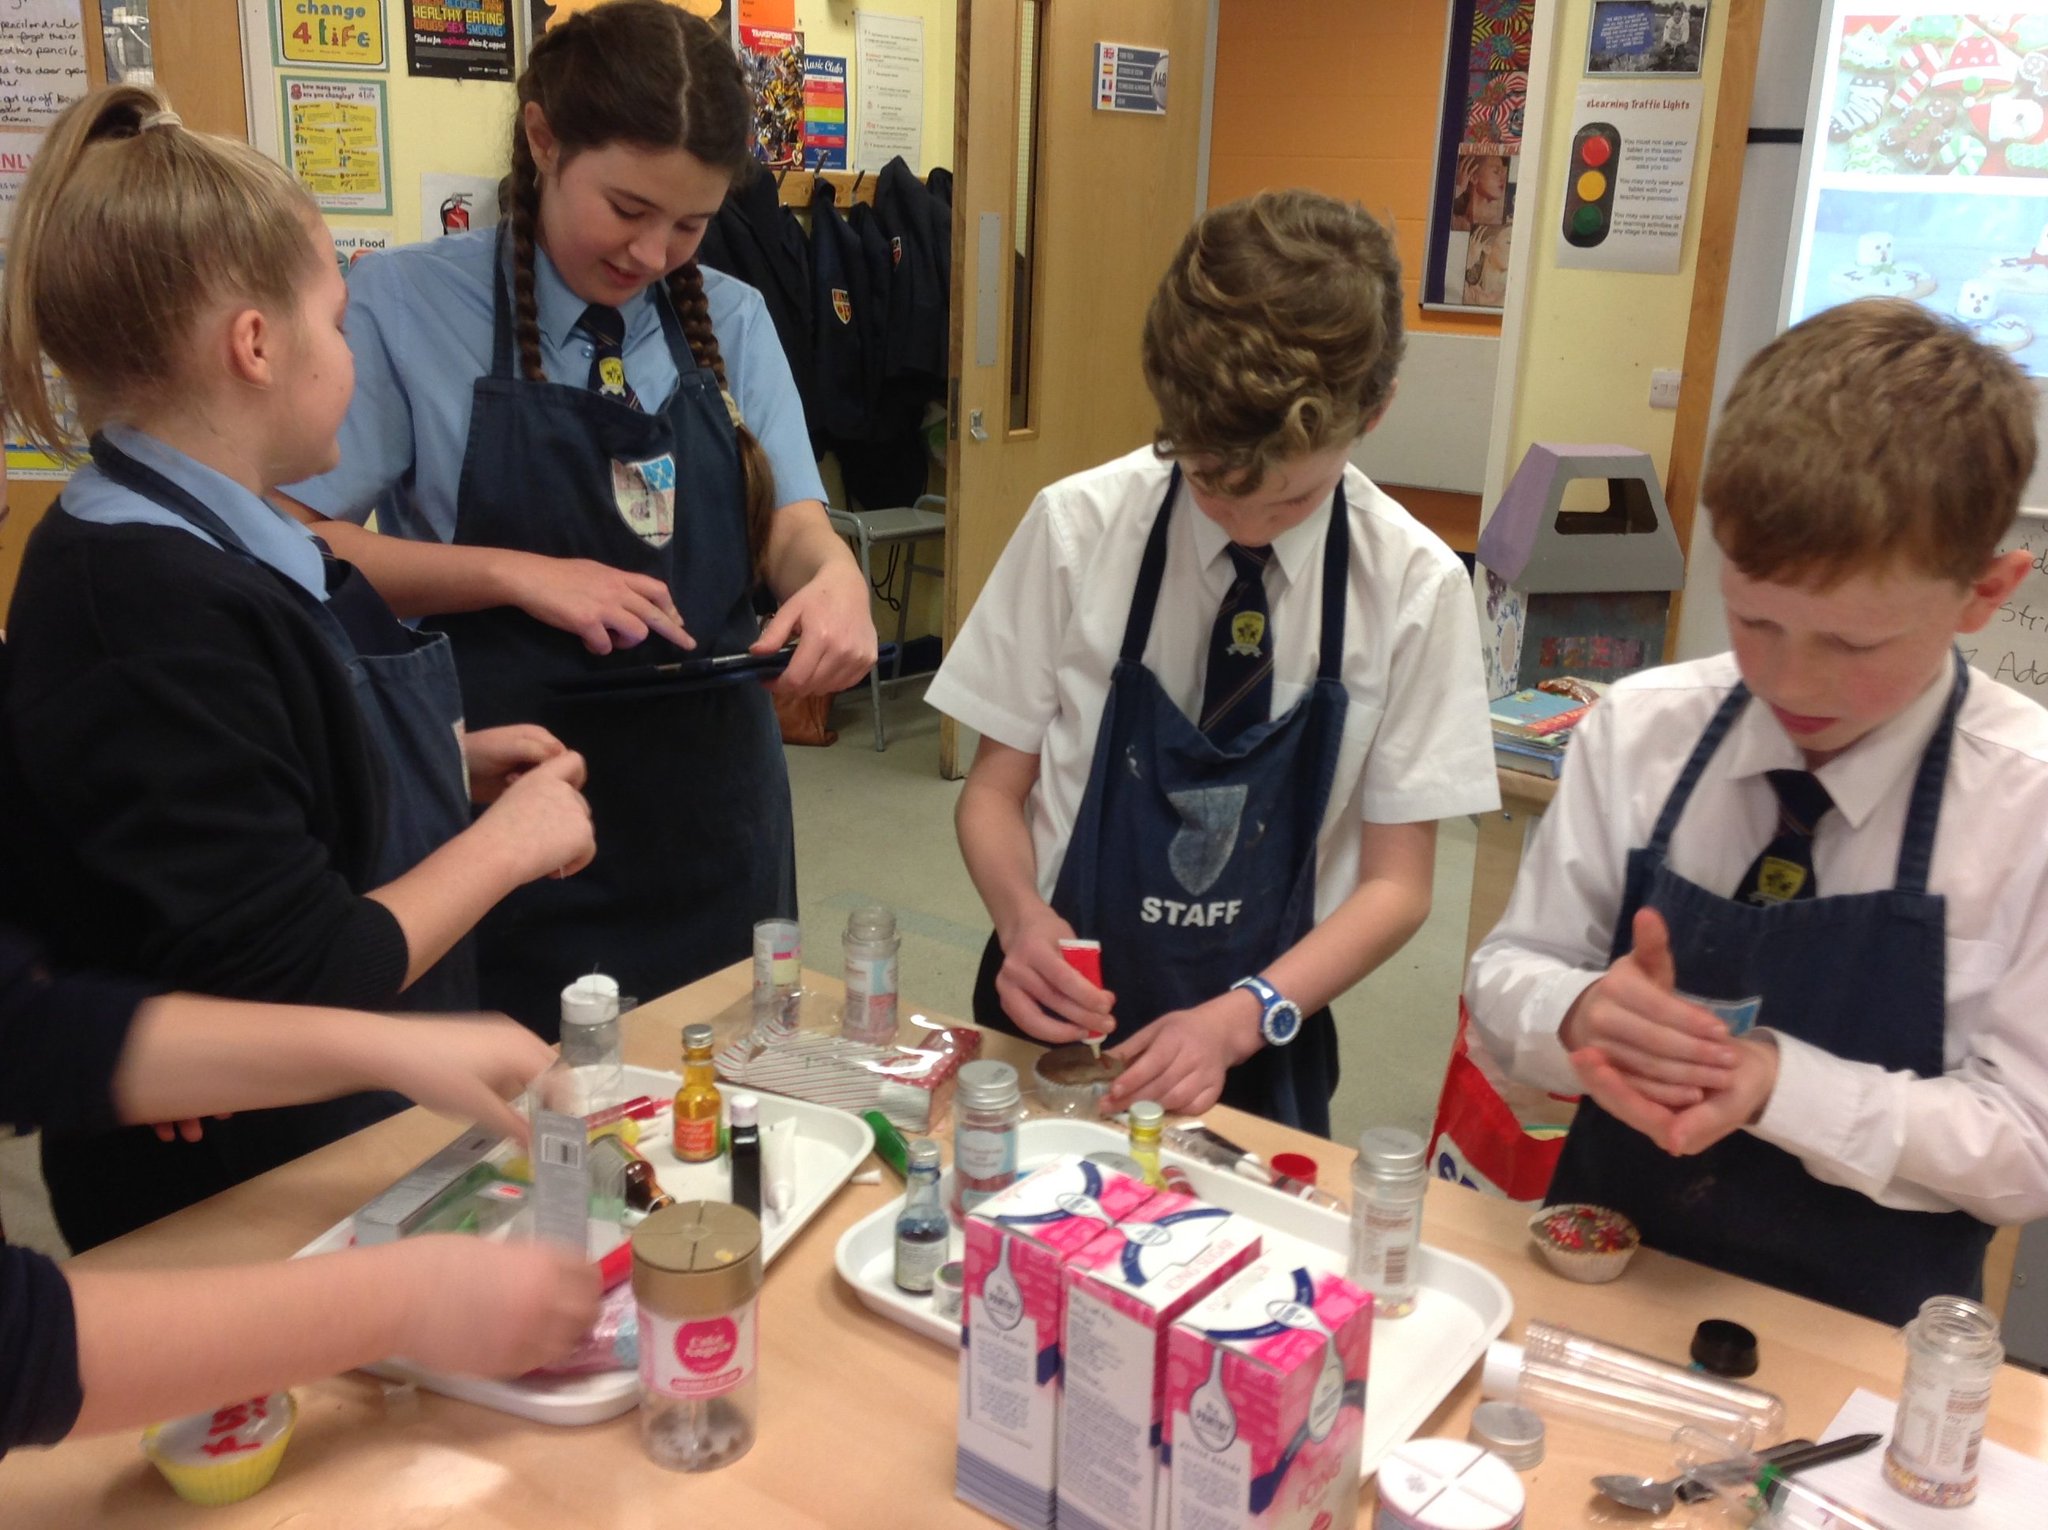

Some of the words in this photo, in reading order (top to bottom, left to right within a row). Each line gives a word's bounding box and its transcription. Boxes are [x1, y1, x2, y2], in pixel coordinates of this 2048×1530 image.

[296, 0, 366, 20] change
[412, 5, 463, 22] HEALTHY
[465, 10, 505, 26] EATING
[292, 21, 312, 45] 4
[414, 19, 445, 32] DRUGS
[446, 21, 465, 34] SEX
[466, 23, 504, 37] SMOKING
[1587, 99, 1629, 110] eLearning
[1631, 99, 1661, 110] Traffic
[1663, 100, 1690, 111] Lights
[335, 238, 355, 247] and
[360, 238, 385, 248] Food
[1141, 896, 1242, 927] STAFF
